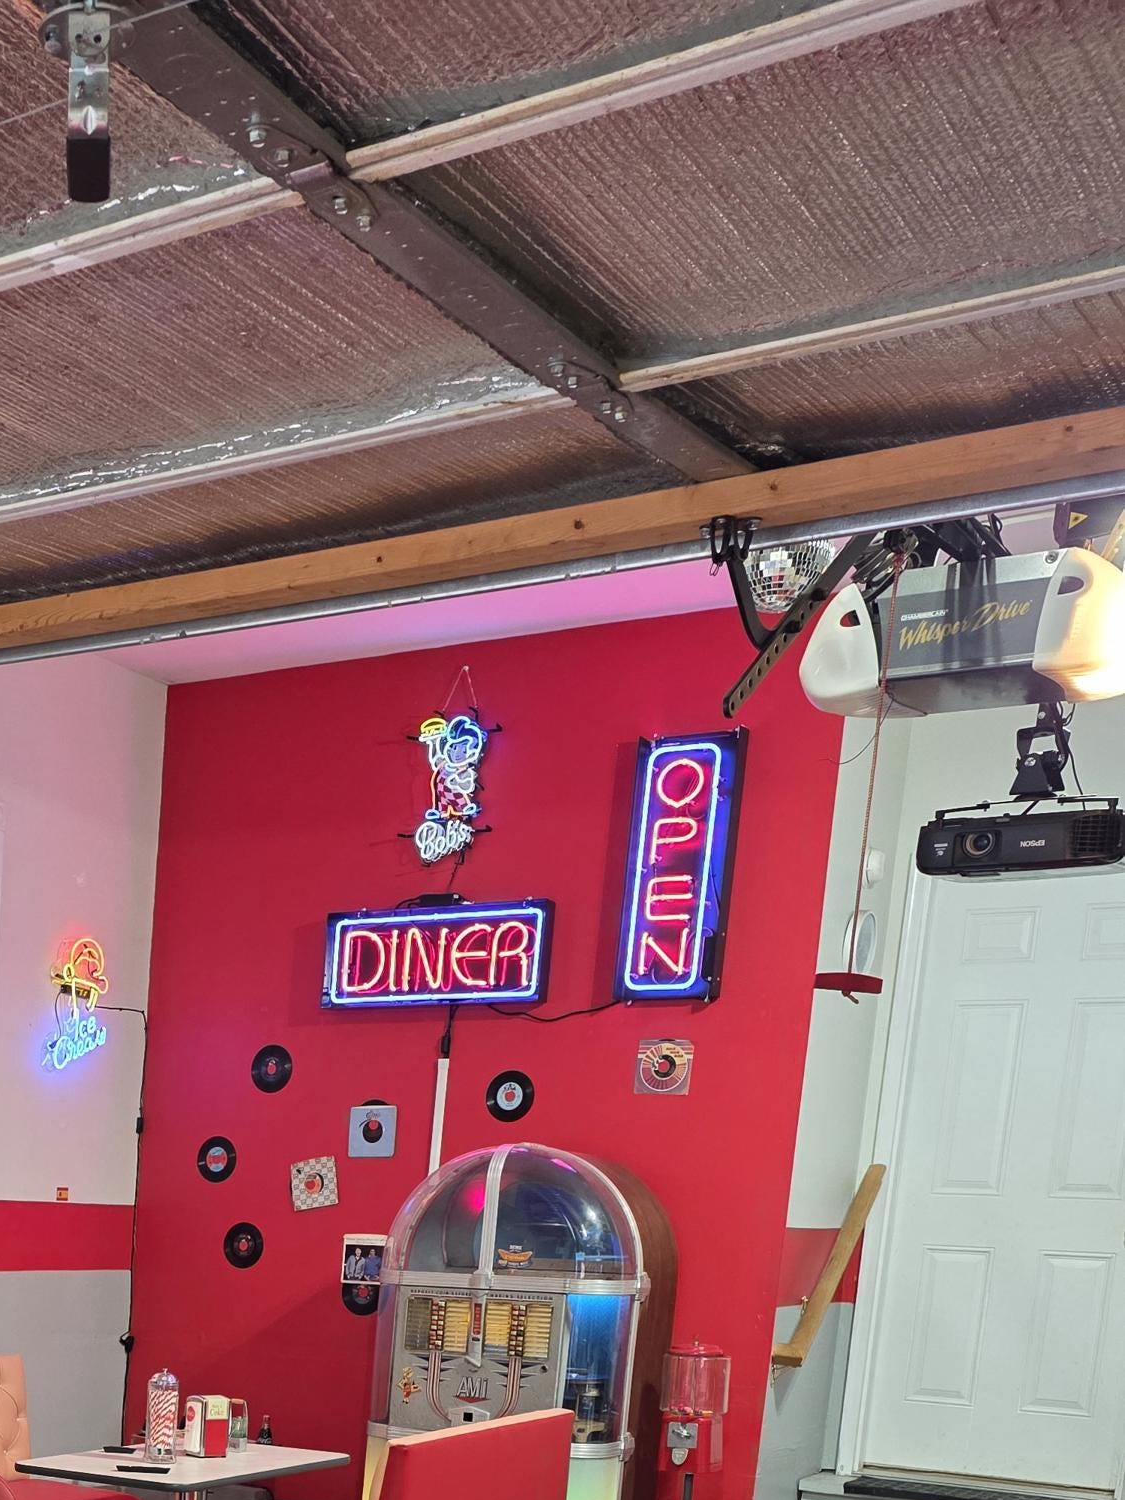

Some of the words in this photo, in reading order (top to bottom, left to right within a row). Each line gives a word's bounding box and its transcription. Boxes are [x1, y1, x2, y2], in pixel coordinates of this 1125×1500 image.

[899, 618, 971, 650] Whisper
[971, 600, 1031, 632] Drive
[415, 819, 474, 862] Bob's
[1019, 839, 1046, 848] EPSON
[638, 759, 704, 976] OPEN
[342, 921, 529, 992] DINER
[73, 1009, 97, 1041] Ice
[48, 1026, 107, 1069] Cream
